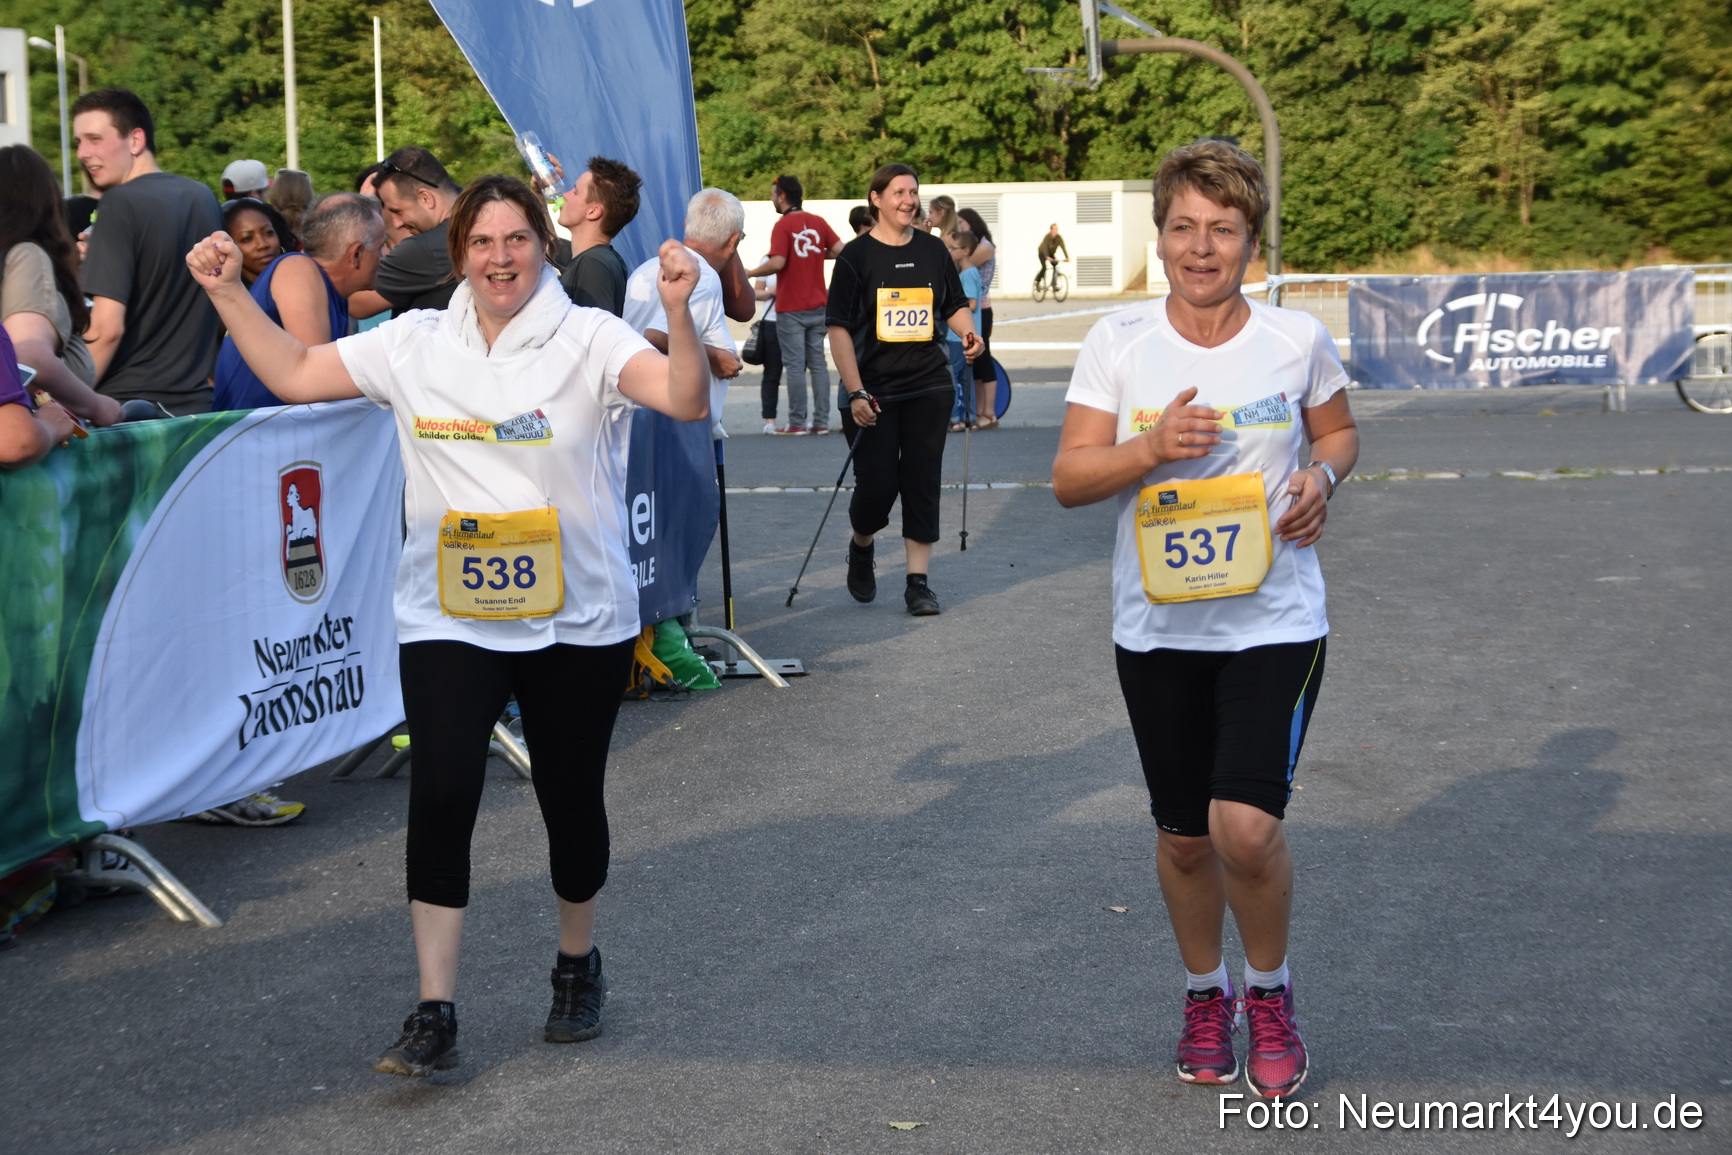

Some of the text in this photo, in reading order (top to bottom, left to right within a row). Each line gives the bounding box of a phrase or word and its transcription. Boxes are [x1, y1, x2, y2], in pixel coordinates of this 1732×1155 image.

[884, 309, 929, 327] 1202
[1453, 319, 1622, 354] Fischer
[1468, 354, 1608, 372] AUTOMOBILE
[1244, 409, 1260, 420] NM
[1267, 404, 1281, 415] NR
[415, 417, 491, 433] Autoschilder
[502, 420, 545, 436] NM NR 1
[418, 430, 485, 441] Schilder Gulder
[1152, 499, 1197, 513] firmenlauf
[453, 529, 495, 539] firmenlauf
[1165, 523, 1241, 569] 537
[294, 568, 317, 590] 1628
[462, 555, 537, 590] 538
[1185, 571, 1229, 583] Karin Hiller
[474, 596, 526, 605] Susanne Endl
